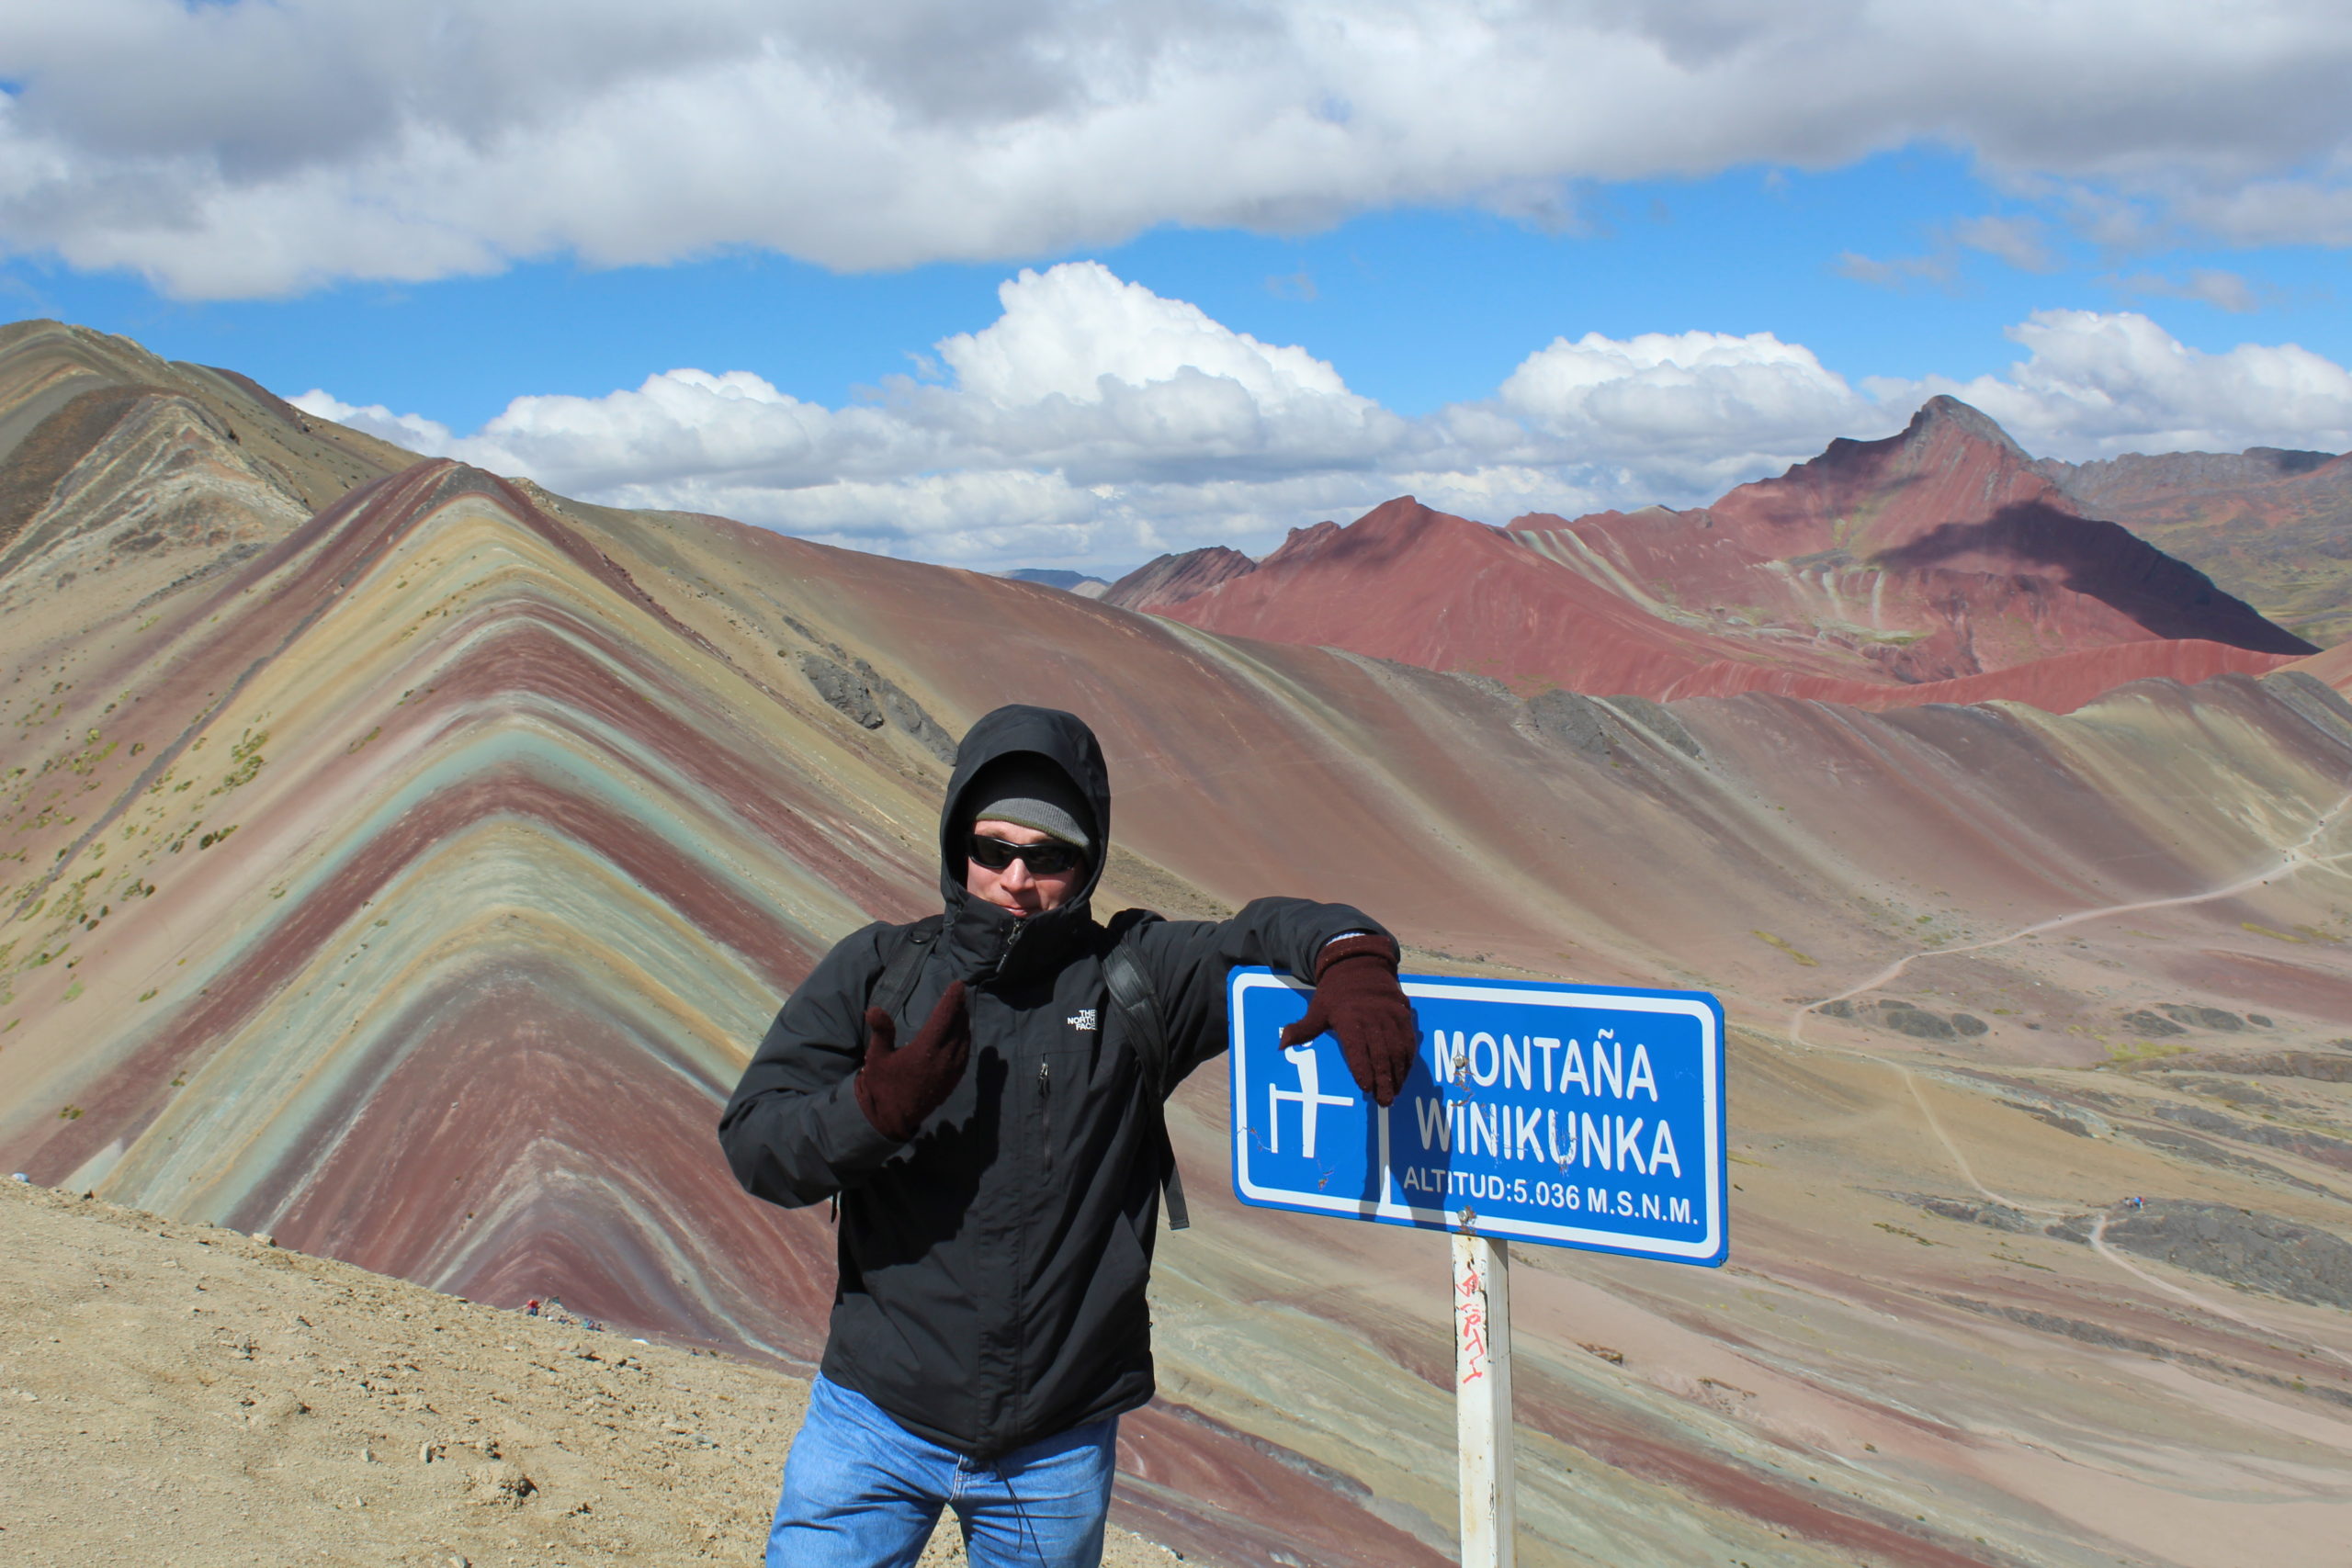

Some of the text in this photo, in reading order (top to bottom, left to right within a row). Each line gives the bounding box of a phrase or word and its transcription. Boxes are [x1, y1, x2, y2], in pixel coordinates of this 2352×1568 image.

[1079, 1010, 1096, 1018] THE
[1433, 1028, 1658, 1101] MONTAÑA
[1415, 1095, 1681, 1179] WINIKUNKA
[1587, 1187, 1699, 1225] M.S.N.M.
